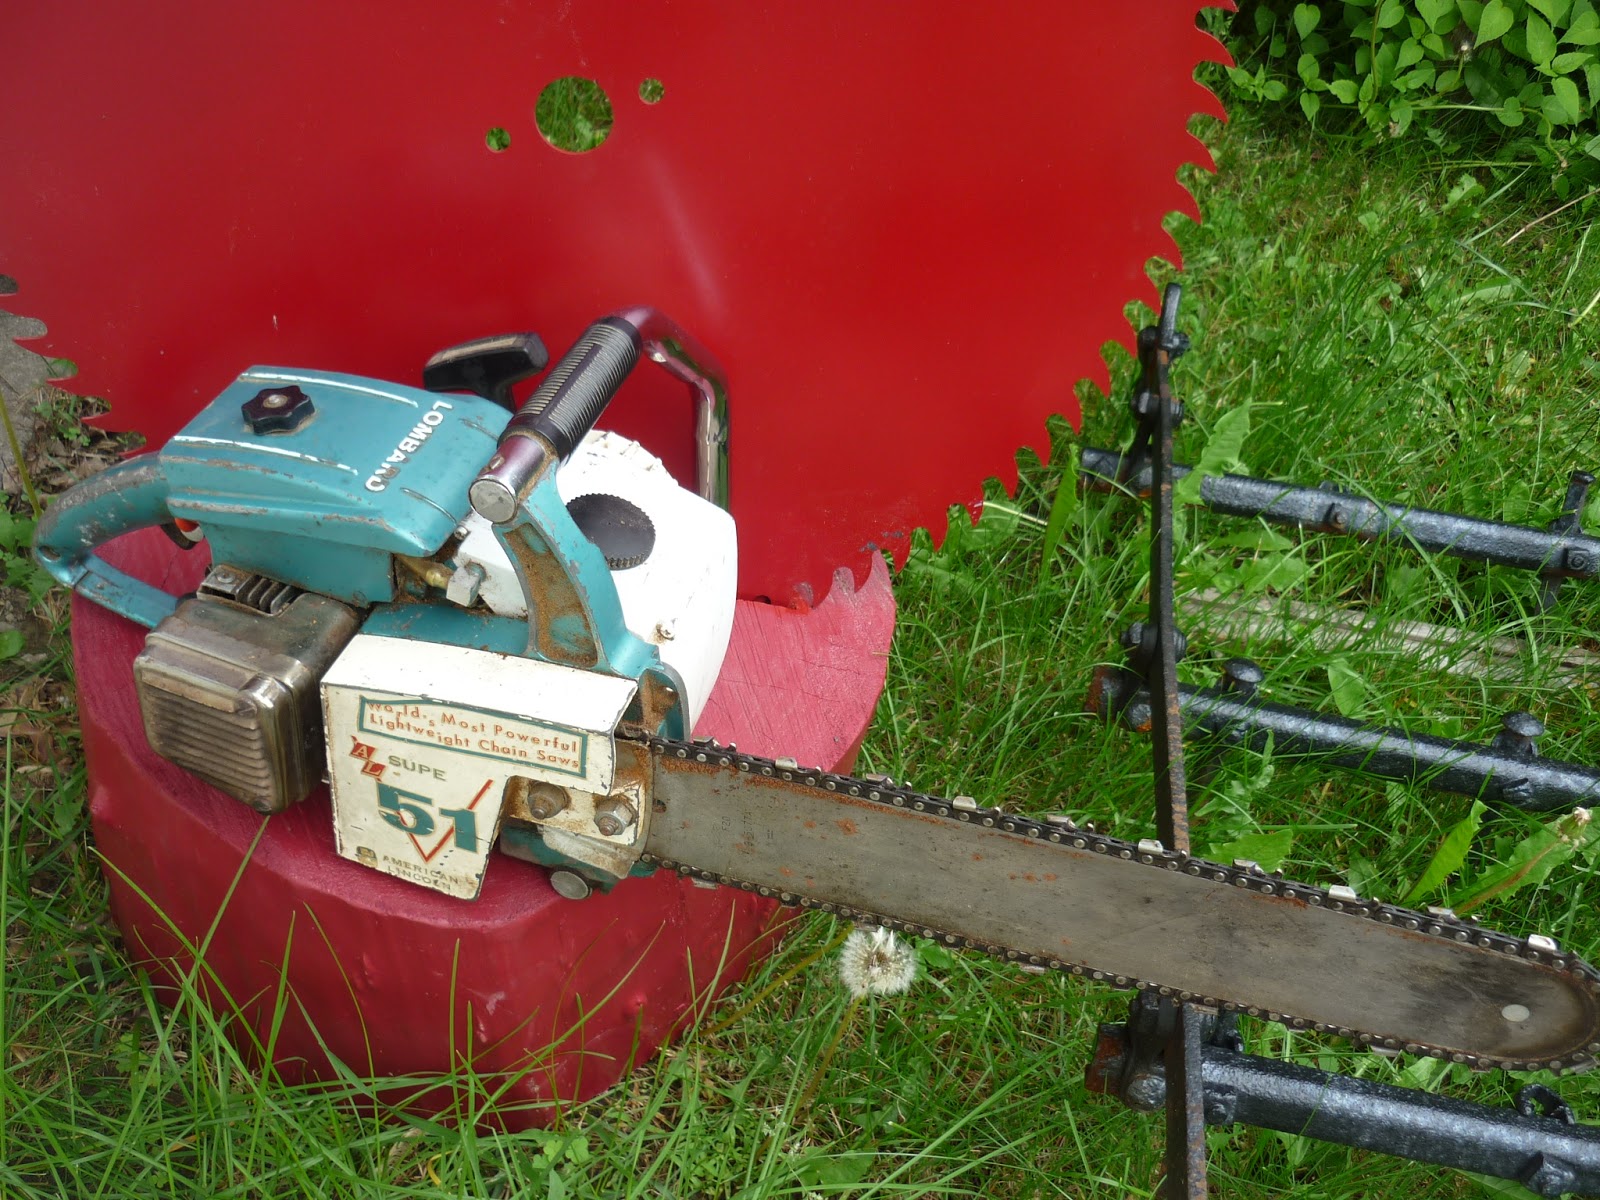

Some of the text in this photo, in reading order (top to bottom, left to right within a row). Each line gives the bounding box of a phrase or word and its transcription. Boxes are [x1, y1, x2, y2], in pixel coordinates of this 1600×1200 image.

[365, 401, 453, 491] LOMBARD
[370, 713, 579, 768] Lightweight Chain Saws
[441, 712, 486, 733] Most
[494, 724, 577, 753] Powerful
[388, 755, 447, 781] SUPE
[377, 783, 478, 853] 51
[382, 855, 459, 884] AMERICAN
[388, 866, 451, 890] LINCOLN
